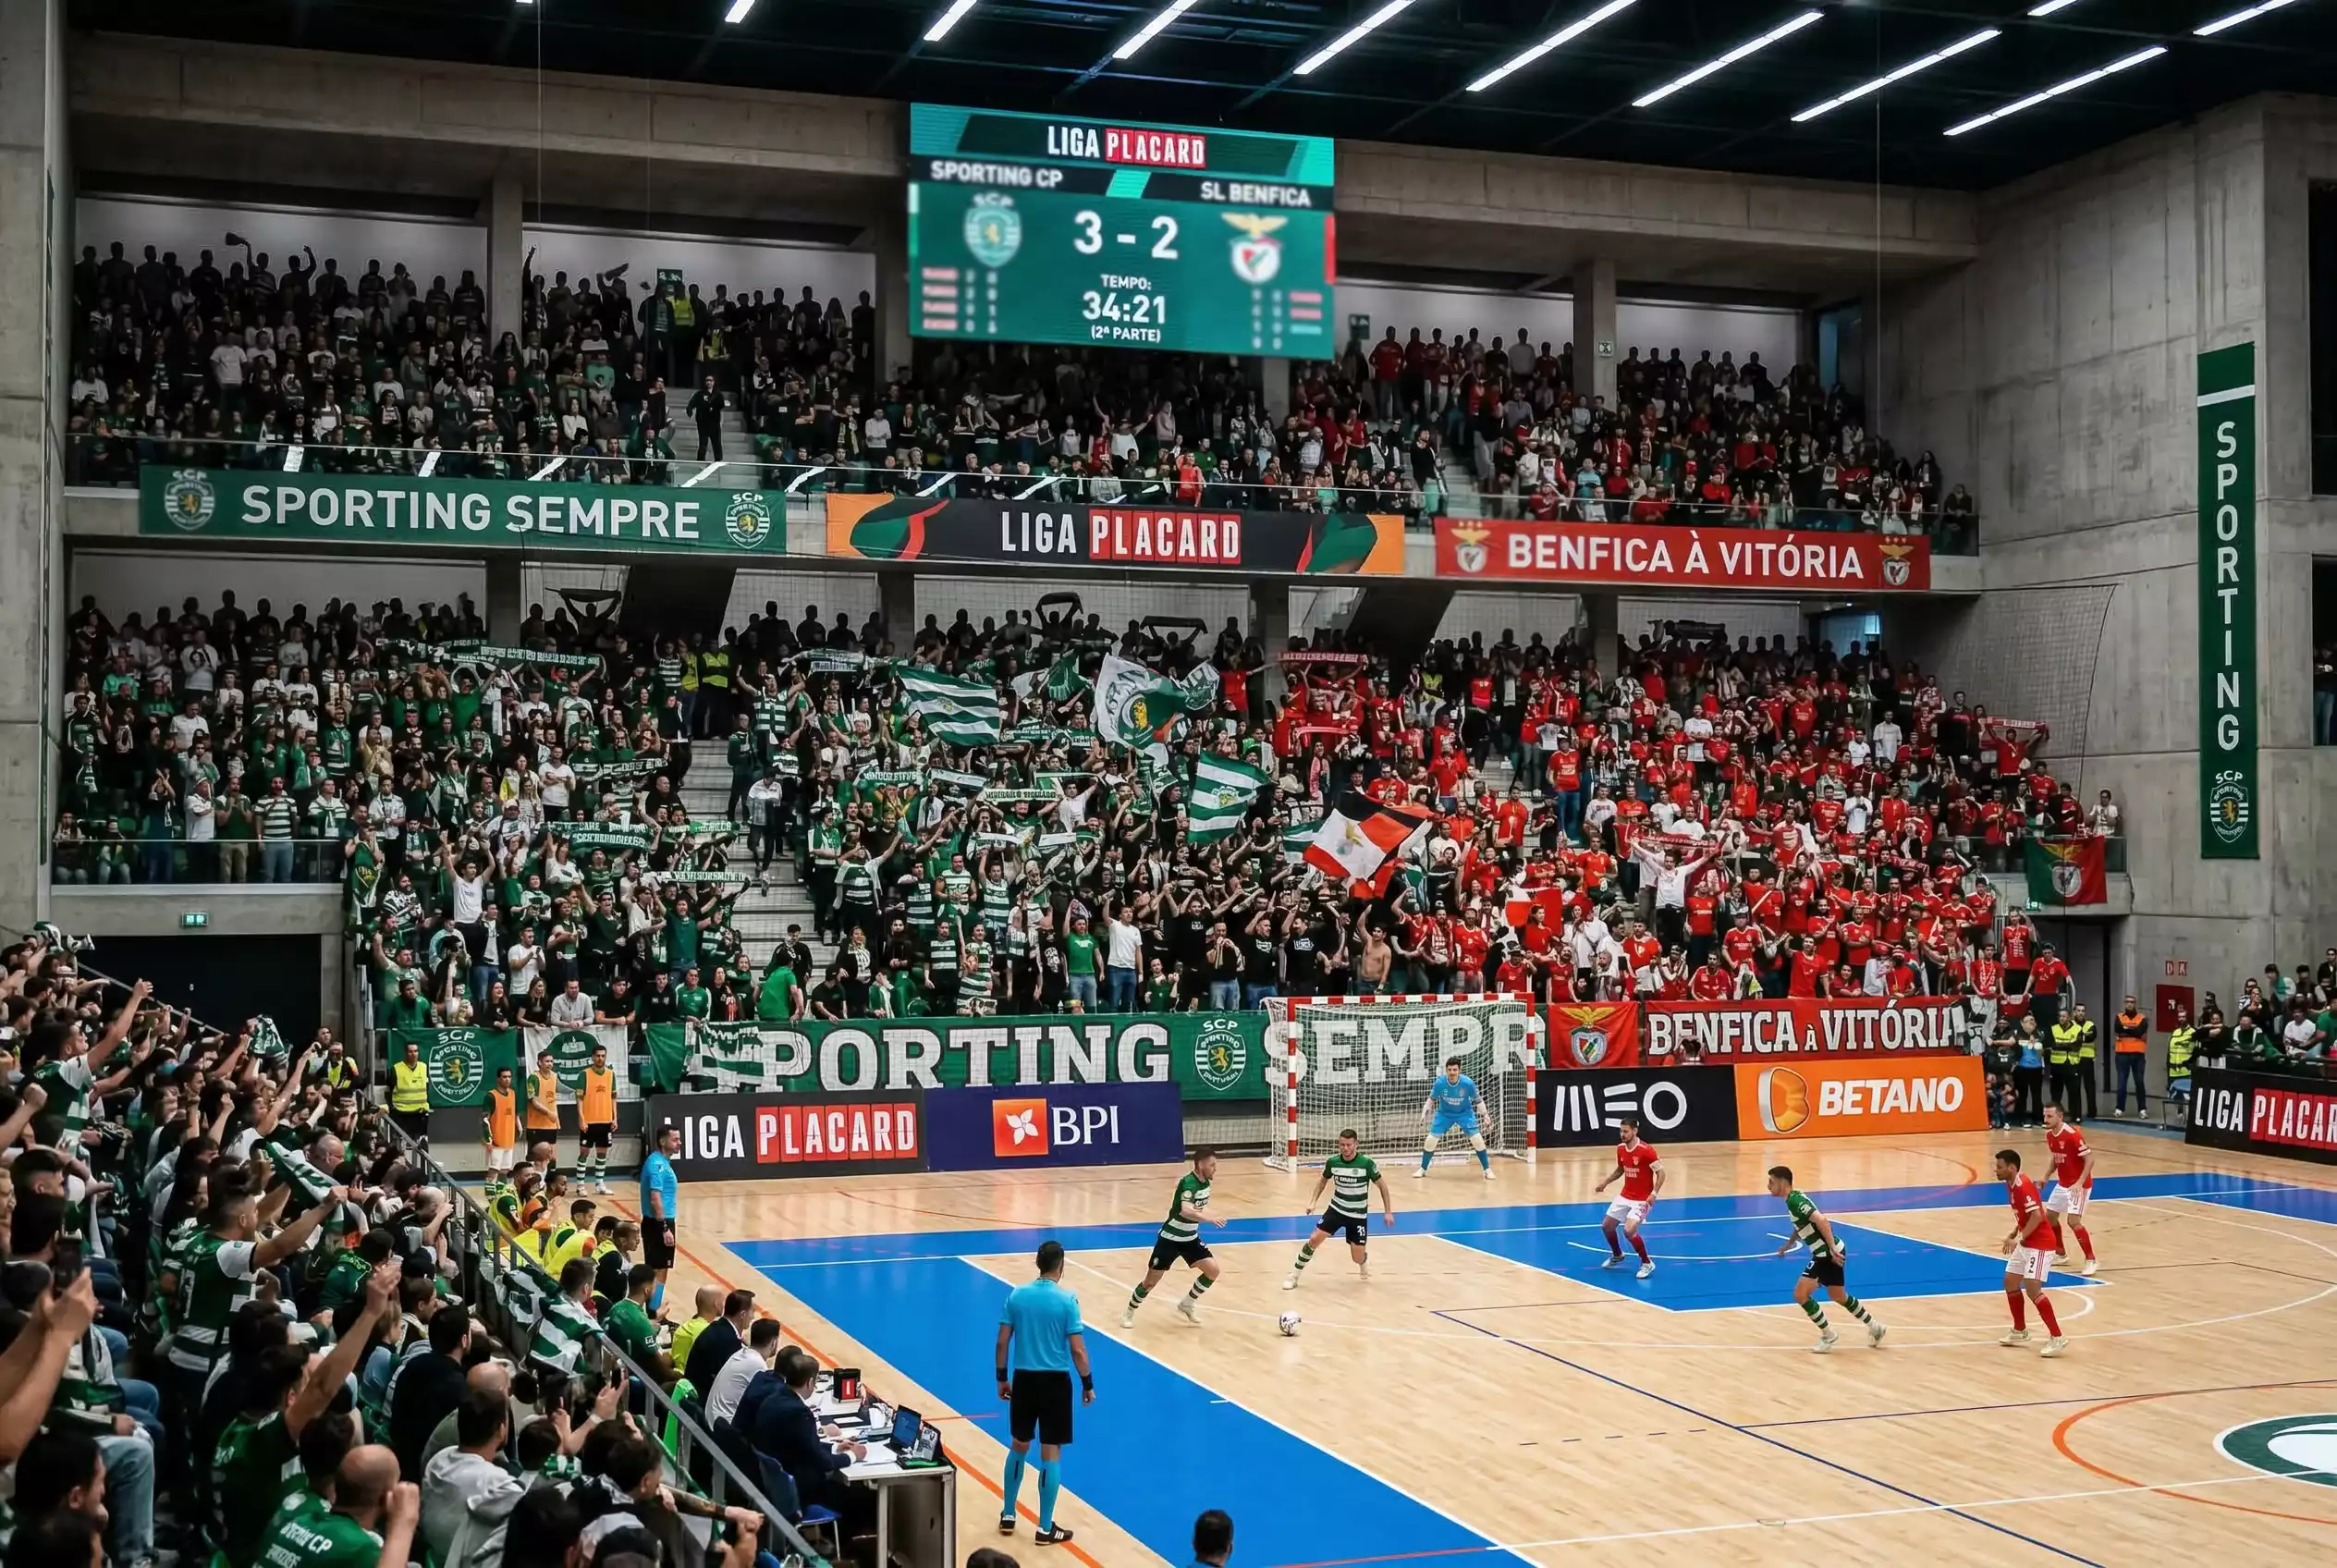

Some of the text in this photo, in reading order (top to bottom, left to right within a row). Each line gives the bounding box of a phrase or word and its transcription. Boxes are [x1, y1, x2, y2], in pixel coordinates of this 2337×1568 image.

[1047, 126, 1205, 165] LIGA PLACARD
[930, 160, 1063, 190] SPORTING CP
[1201, 180, 1312, 207] SL BENFICA
[1074, 210, 1103, 254] 3
[1151, 215, 1180, 260] 2
[1100, 274, 1152, 290] TEMPO:
[1082, 290, 1166, 325] 34:21
[1112, 326, 1161, 343] PARTE)
[241, 485, 700, 539] SPORTING SEMPRE
[1001, 510, 1241, 559] LIGA PLACARD
[1509, 530, 1864, 580] BENFICA À VITÓRIA
[2216, 420, 2240, 752] SPORTING
[2215, 770, 2244, 784] SCP
[437, 1029, 475, 1044] SCP
[1203, 1018, 1238, 1032] SCP
[679, 1022, 1170, 1095] PORTING
[1553, 1081, 1688, 1132] MEO
[1818, 1075, 1964, 1116] BETANO
[2195, 1087, 2244, 1132] LIGA
[664, 1110, 916, 1159] IGA PLACARD
[1051, 1105, 1120, 1146] BPI
